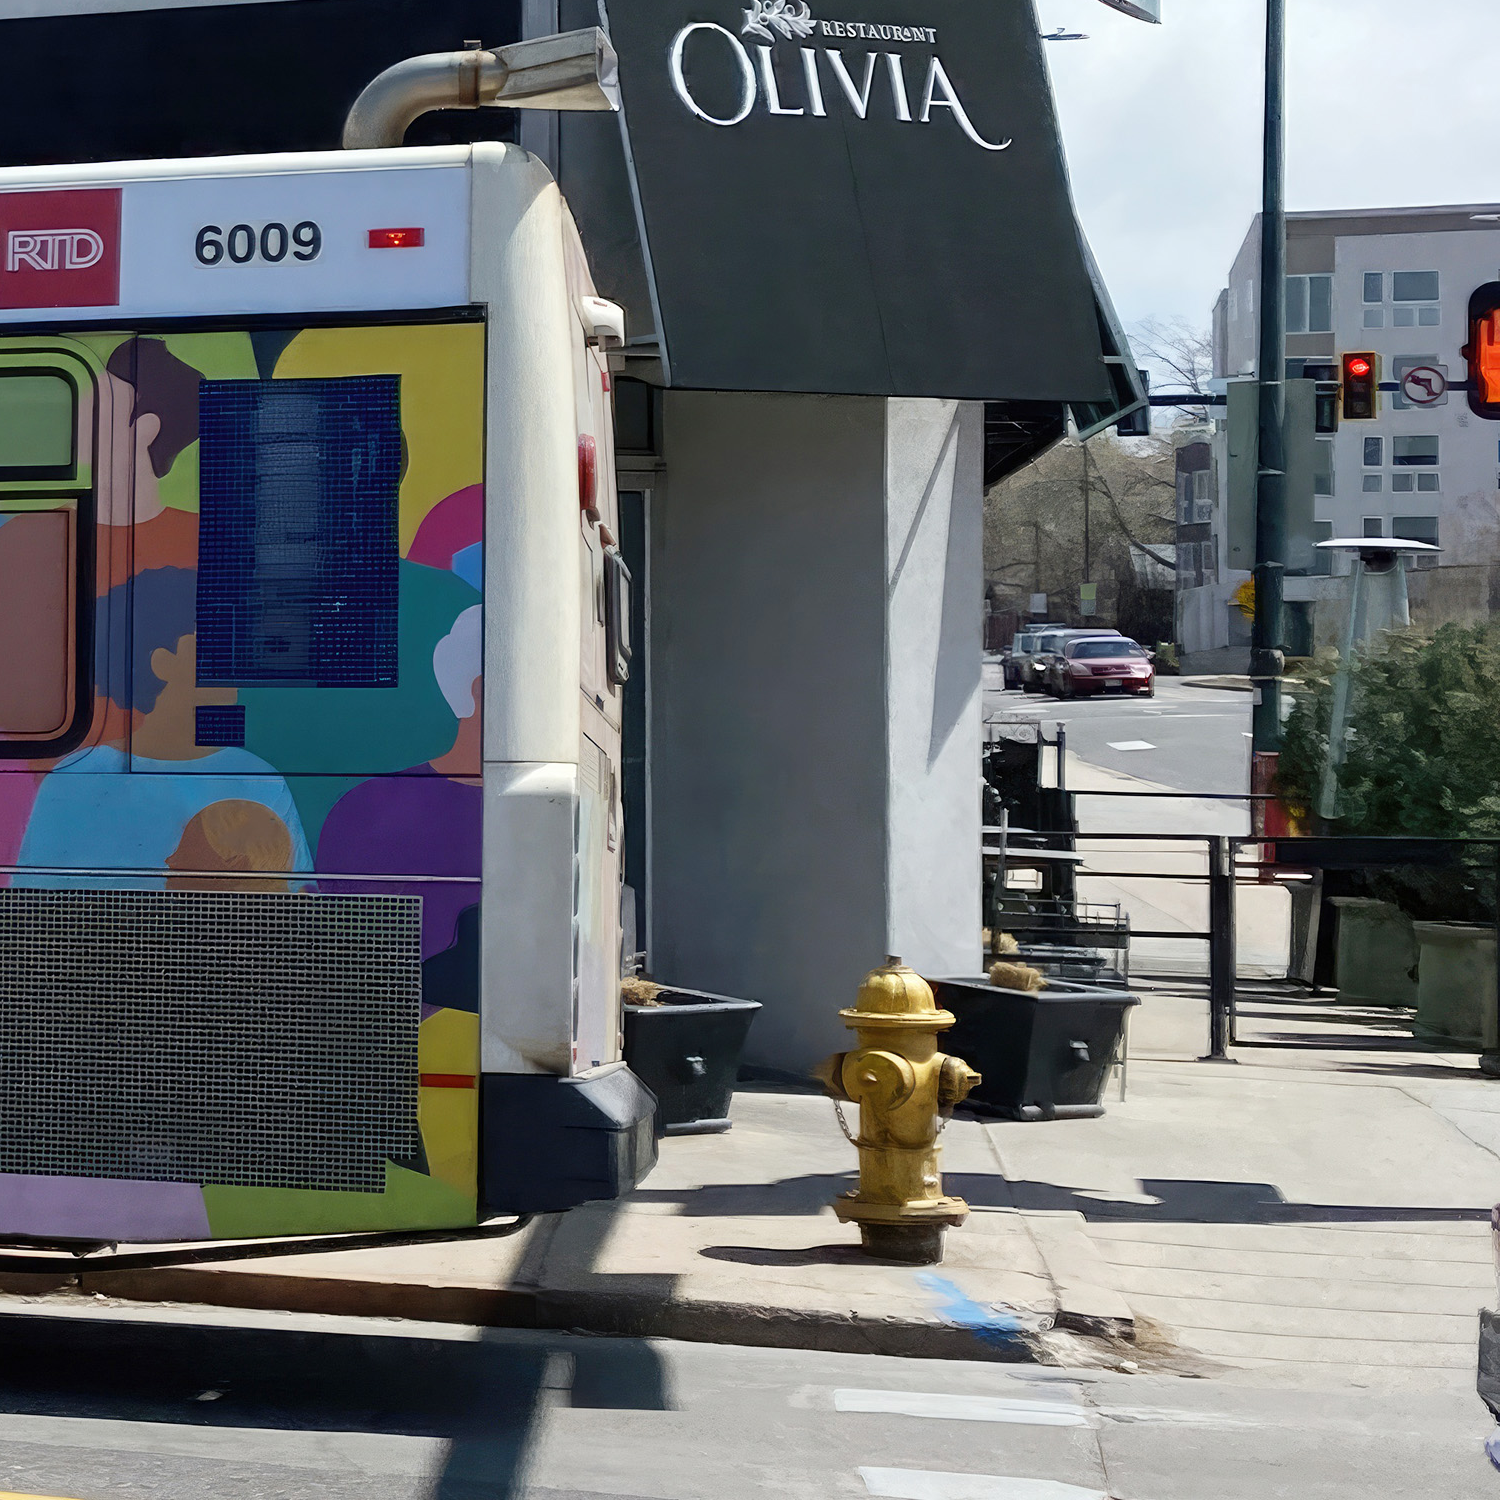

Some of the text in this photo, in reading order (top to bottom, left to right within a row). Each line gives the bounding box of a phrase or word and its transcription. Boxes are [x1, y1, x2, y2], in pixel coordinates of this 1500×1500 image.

[822, 20, 937, 44] RESTAURANT
[668, 22, 1013, 151] OLIVIA
[5, 228, 104, 272] RTD
[193, 221, 323, 264] 6009
